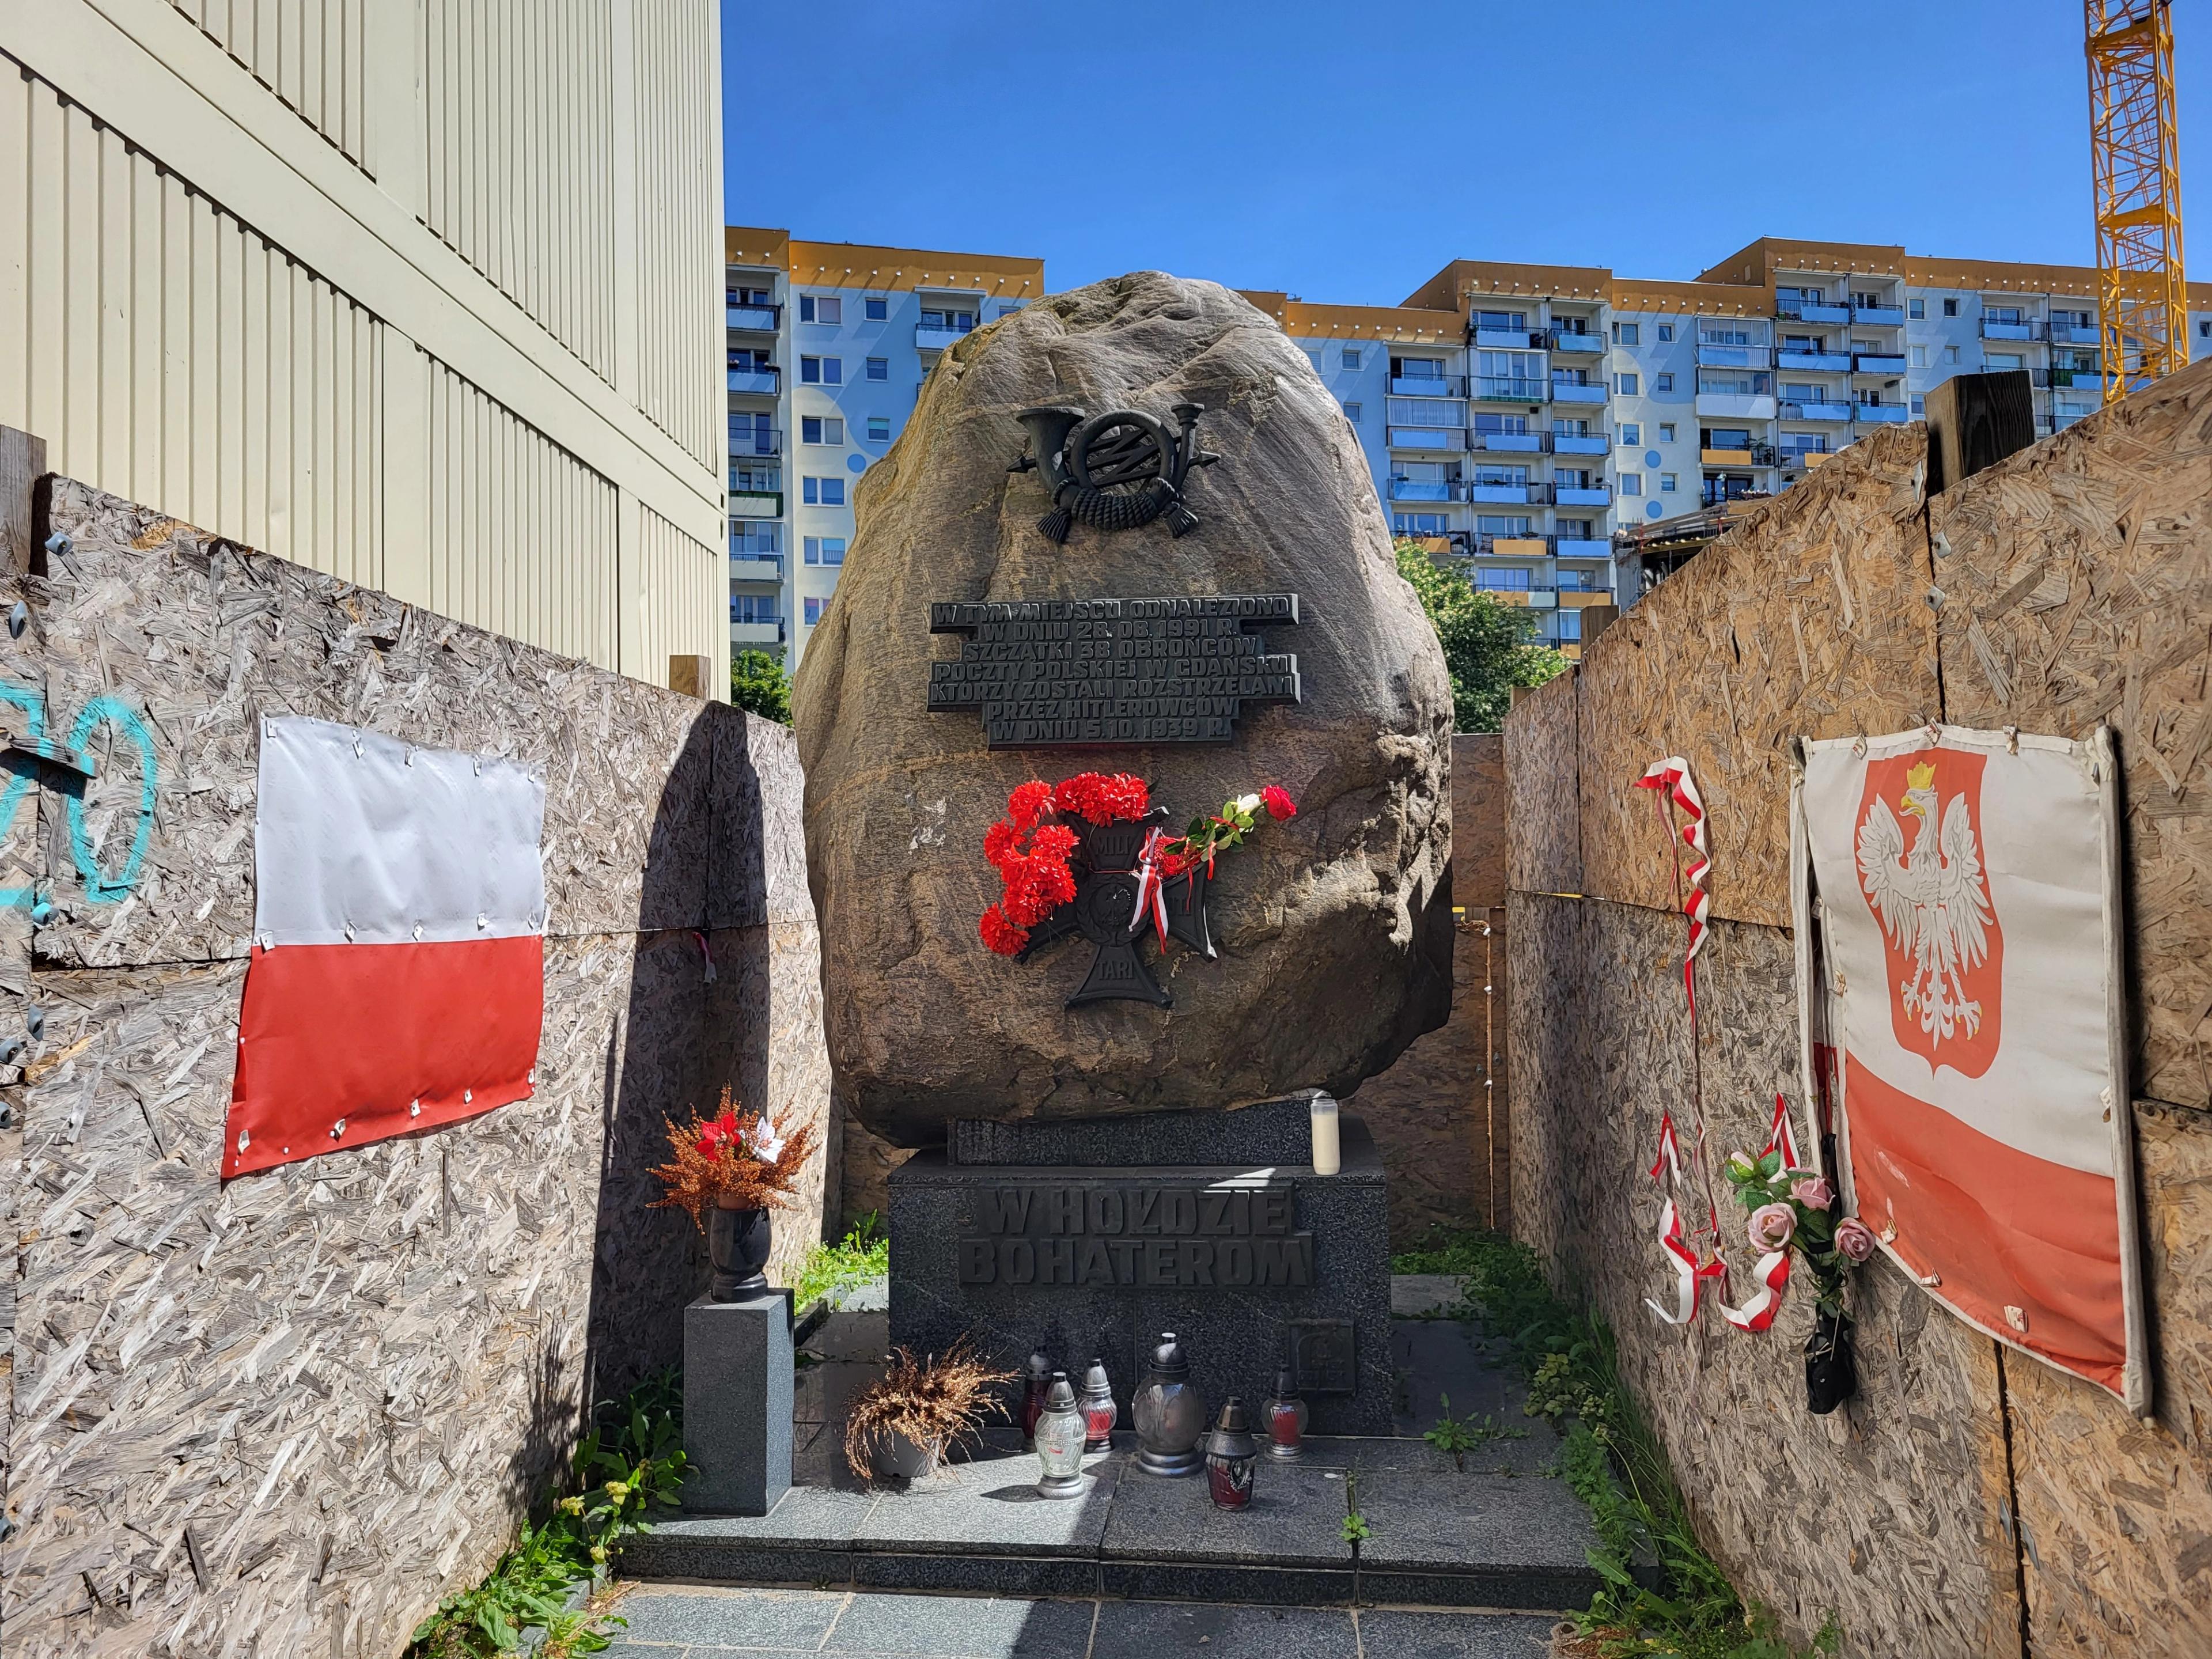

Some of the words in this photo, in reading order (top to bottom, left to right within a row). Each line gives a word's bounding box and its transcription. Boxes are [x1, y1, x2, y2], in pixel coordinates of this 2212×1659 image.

[934, 605, 957, 623] W
[963, 603, 1012, 622] TYM
[1019, 601, 1120, 620] MIEJSCU
[1129, 597, 1289, 618] ODNALEZIONO
[984, 624, 1006, 641] W
[1014, 622, 1069, 641] DNIU
[1217, 619, 1237, 636] R.
[964, 642, 1071, 662] SZCZĄTKI
[1080, 641, 1110, 659] 38
[1119, 637, 1256, 658] OBROŃCÓW
[934, 663, 1023, 681] POCZTY
[1030, 661, 1135, 680] POLSKIEJ
[1146, 660, 1167, 677] W
[1174, 656, 1288, 677] GDAŃSKU
[931, 681, 1018, 701] KTÓRZY
[1022, 680, 1113, 700] ZOSTALI
[1124, 676, 1293, 697] ROZSTRZELANI
[987, 700, 1059, 720] PRZEZ
[1067, 696, 1234, 718] HITLEROWCÓW
[993, 722, 1017, 740] W
[1022, 721, 1078, 739] DNIU
[1208, 718, 1229, 736] R.
[1096, 835, 1131, 857] MILI
[1097, 959, 1134, 983] TARI
[984, 1189, 1033, 1234] W
[1050, 1189, 1287, 1235] HOŁDZIE
[961, 1239, 1309, 1287] BOHATEROM
